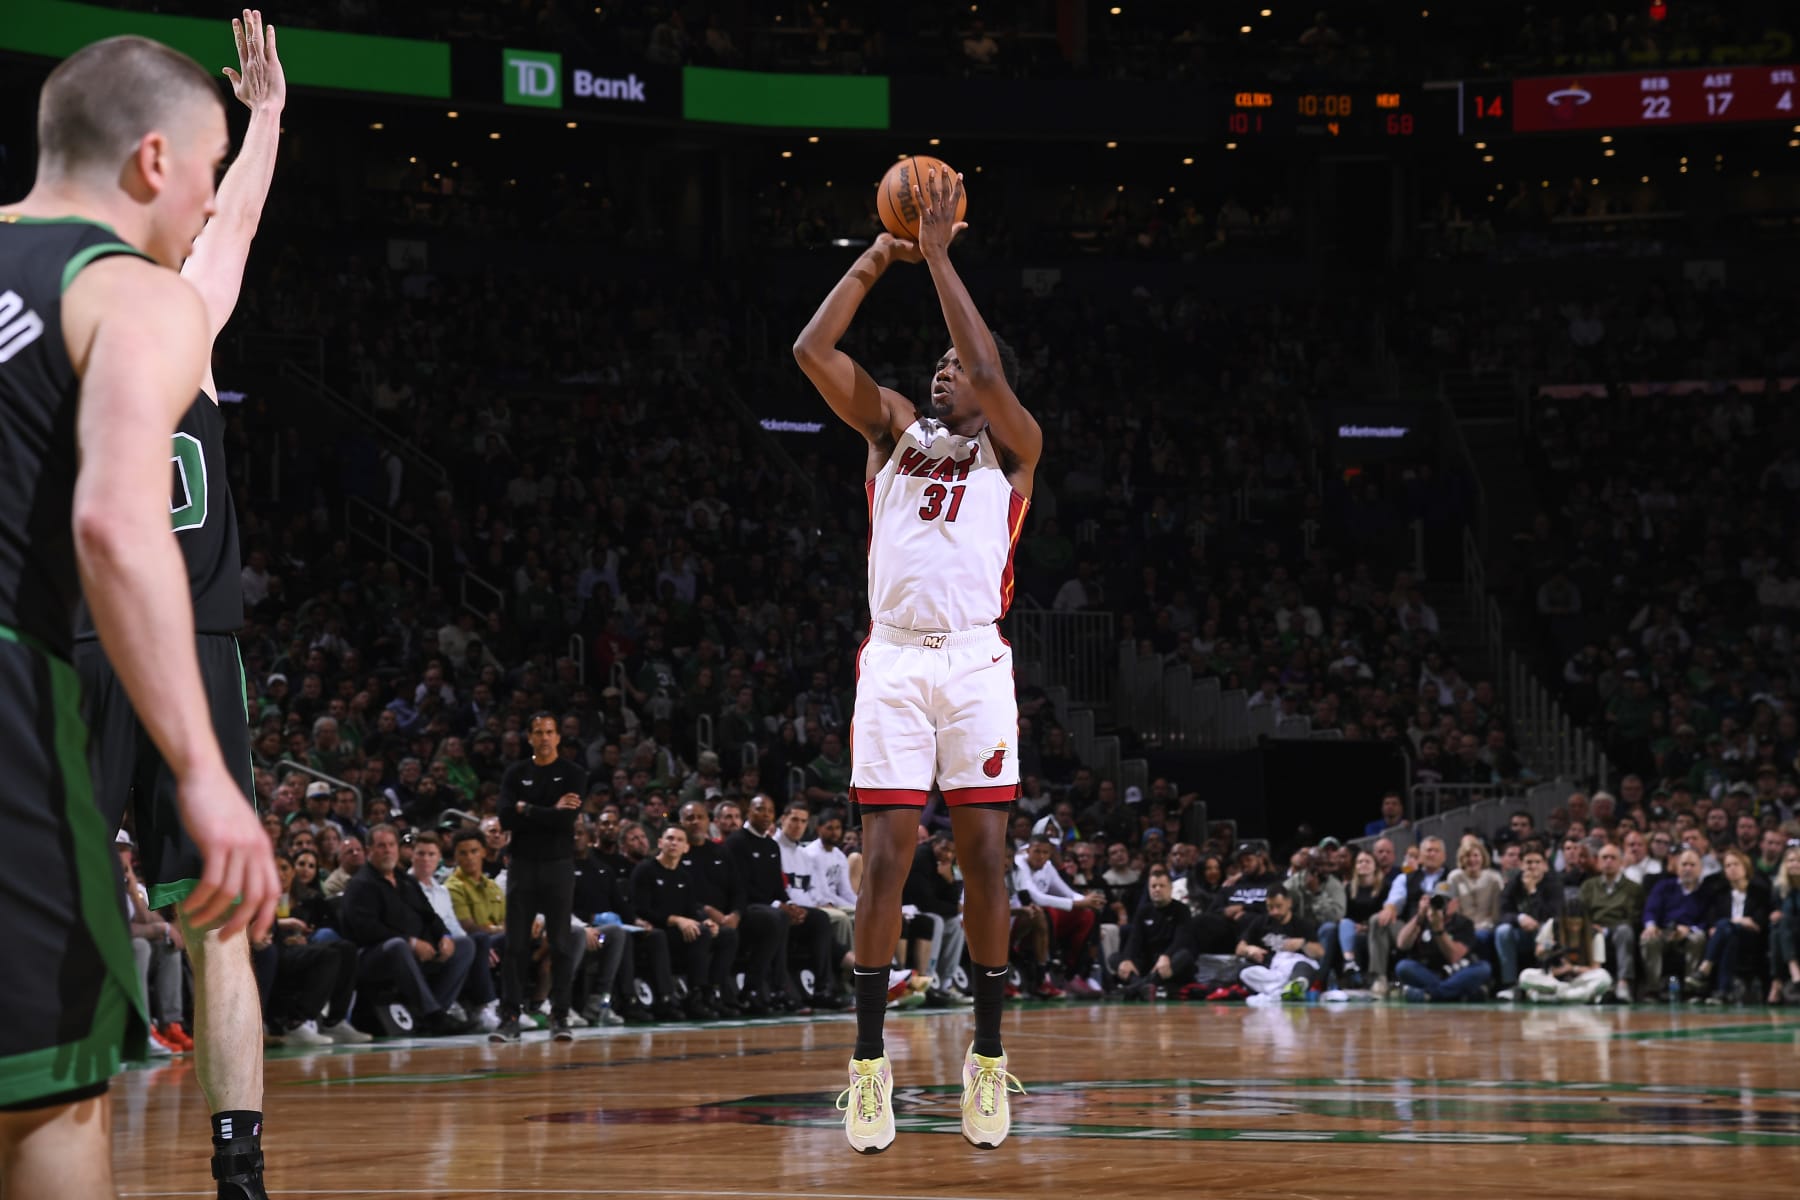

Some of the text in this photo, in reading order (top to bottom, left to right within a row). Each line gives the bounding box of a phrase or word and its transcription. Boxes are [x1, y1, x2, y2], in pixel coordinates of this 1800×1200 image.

[509, 58, 645, 102] TD Bank
[1641, 70, 1796, 91] REB AST STL
[1474, 96, 1504, 118] 14
[1642, 90, 1793, 118] 22 17 4
[896, 440, 979, 482] HEAT
[918, 483, 966, 522] 31
